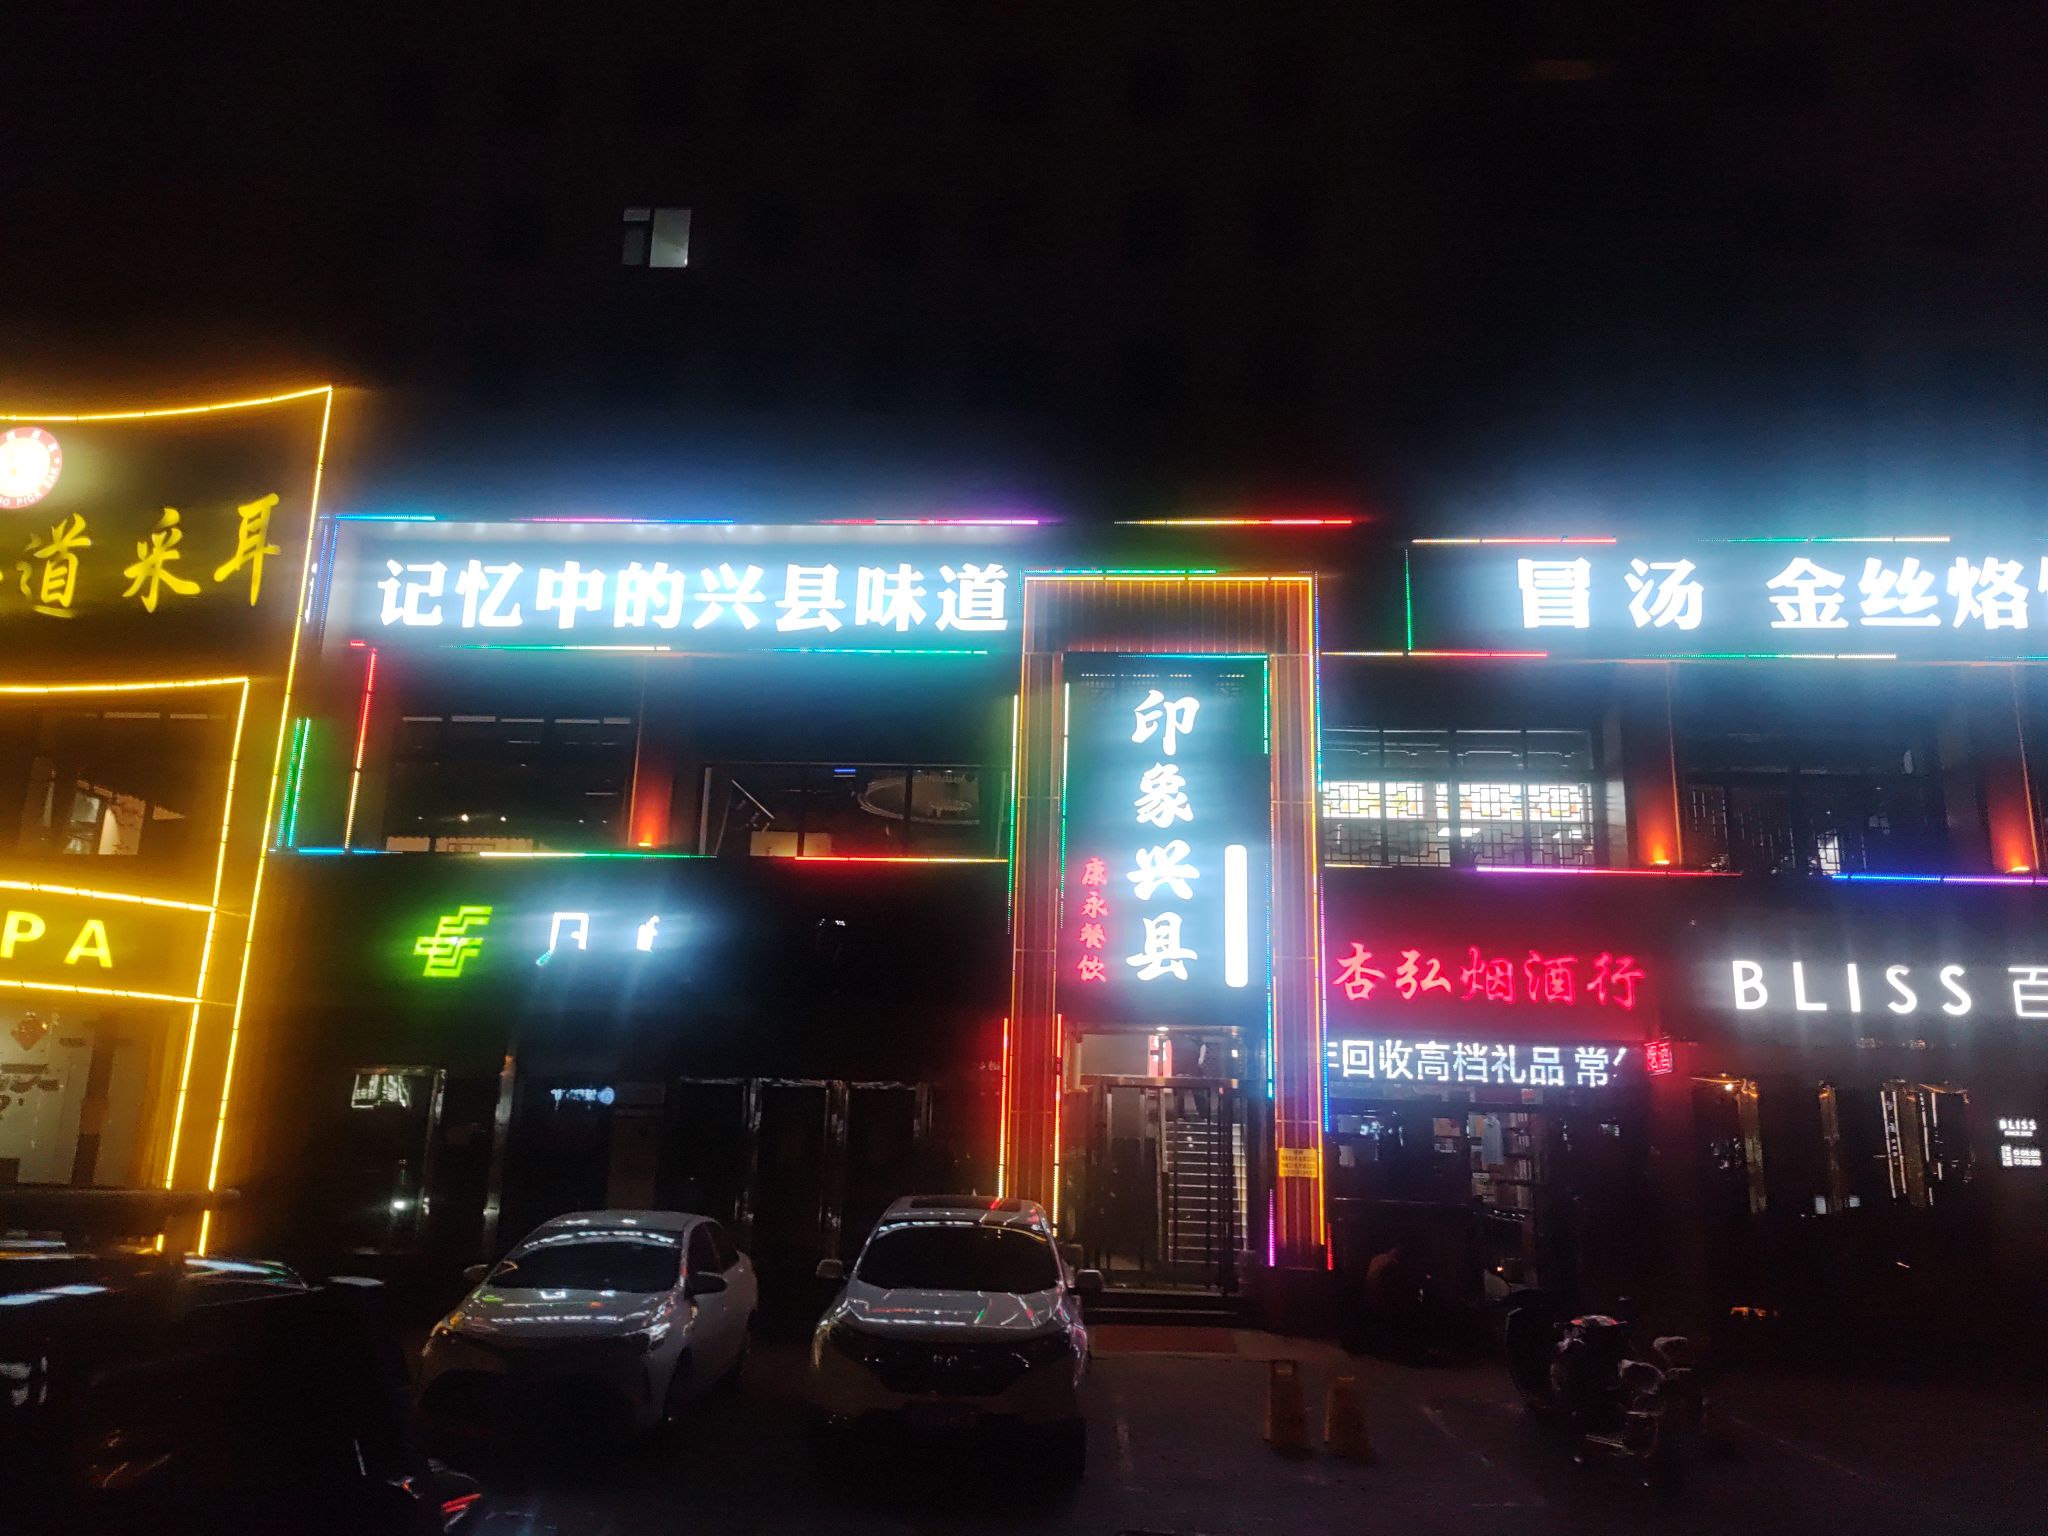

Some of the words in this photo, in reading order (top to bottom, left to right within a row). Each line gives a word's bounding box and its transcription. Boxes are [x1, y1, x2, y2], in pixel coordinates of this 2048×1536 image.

[0, 493, 281, 619] 道采耳
[1516, 557, 1704, 630] 冒汤
[1766, 556, 2048, 630] 金丝烙
[376, 559, 1009, 633] 记忆中的兴县味道
[1125, 689, 1200, 982] 印象兴县
[1332, 943, 1646, 1010] 杏弘烟酒行
[1732, 960, 1973, 1016] BLISS
[1999, 1118, 2037, 1130] BLISS
